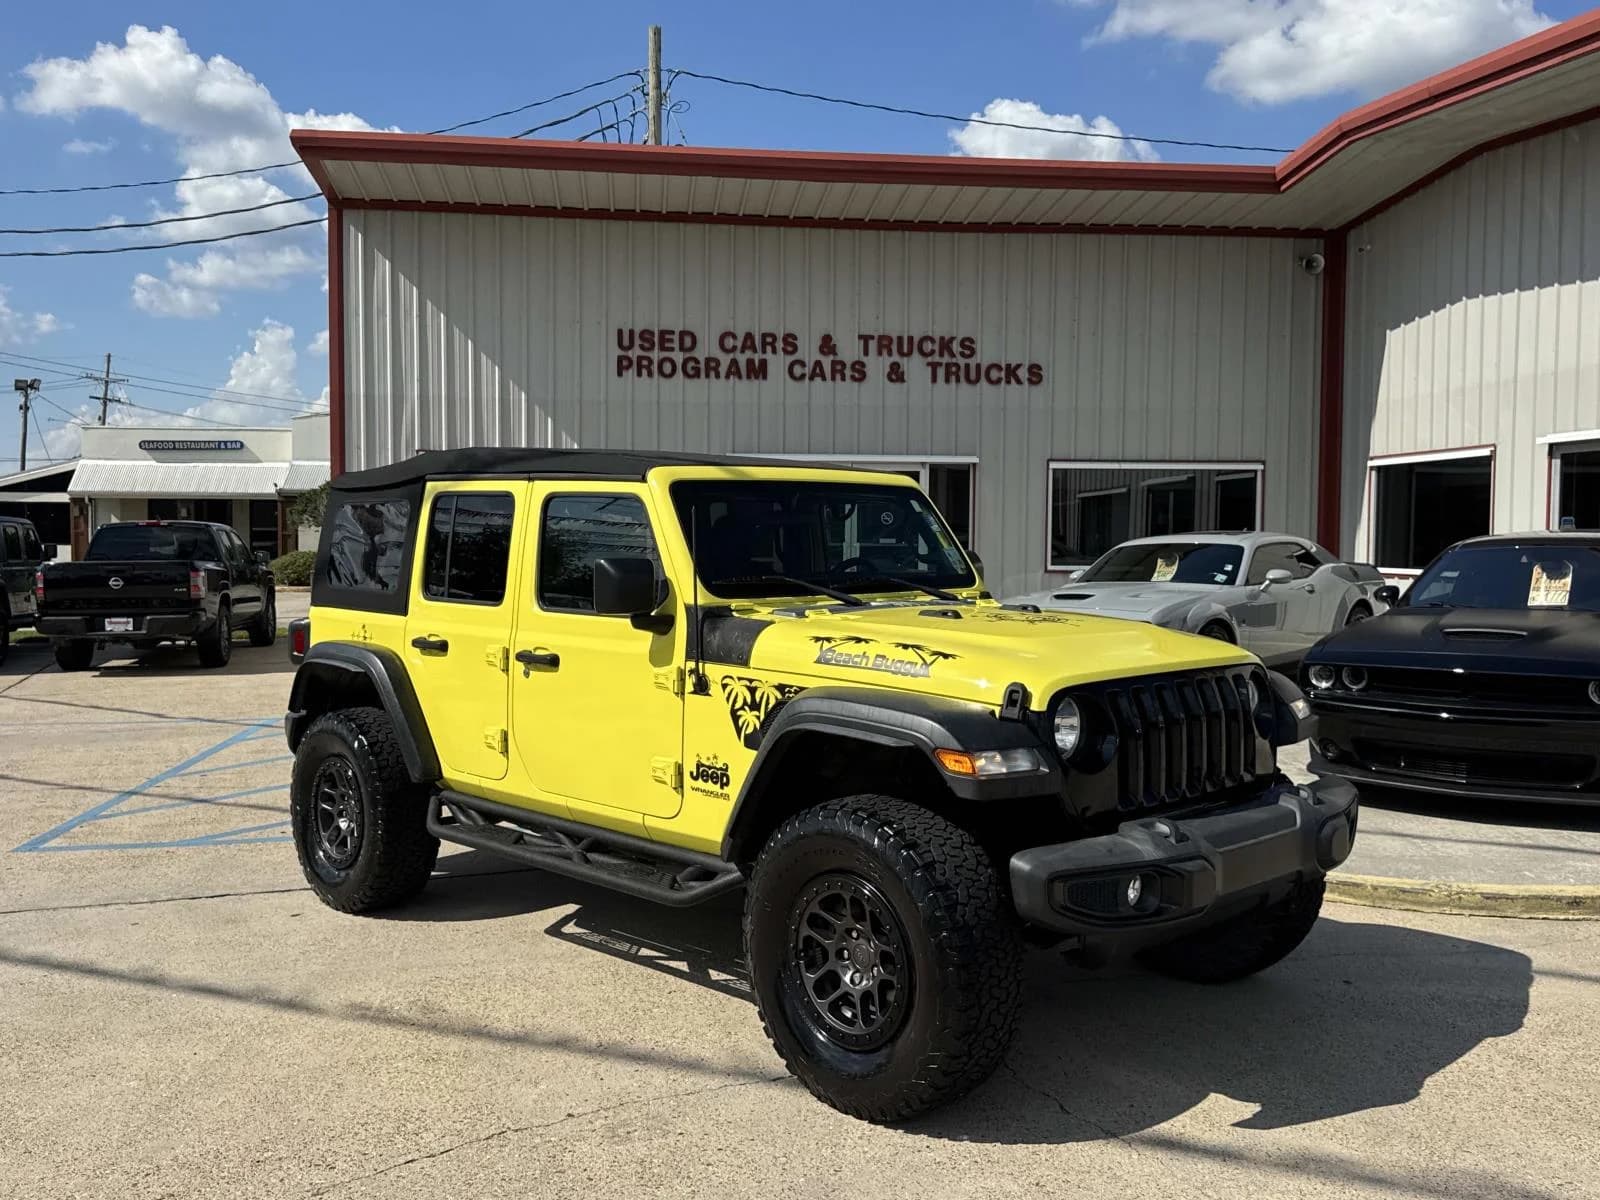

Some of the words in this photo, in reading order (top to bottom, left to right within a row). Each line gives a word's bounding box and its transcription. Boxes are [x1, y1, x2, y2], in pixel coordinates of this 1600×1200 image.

[617, 328, 698, 352] USED
[718, 331, 799, 355] CARS
[818, 334, 837, 357] &
[858, 334, 977, 359] TRUCKS
[616, 354, 769, 381] PROGRAM
[787, 359, 867, 383] CARS
[886, 362, 906, 383] &
[926, 361, 1044, 386] TRUCKS
[141, 441, 174, 449] SEAFOOD
[175, 441, 218, 449] RESTAURANT
[227, 441, 241, 449] BAR
[689, 761, 730, 790] Jeep
[690, 786, 730, 798] WRANGLER
